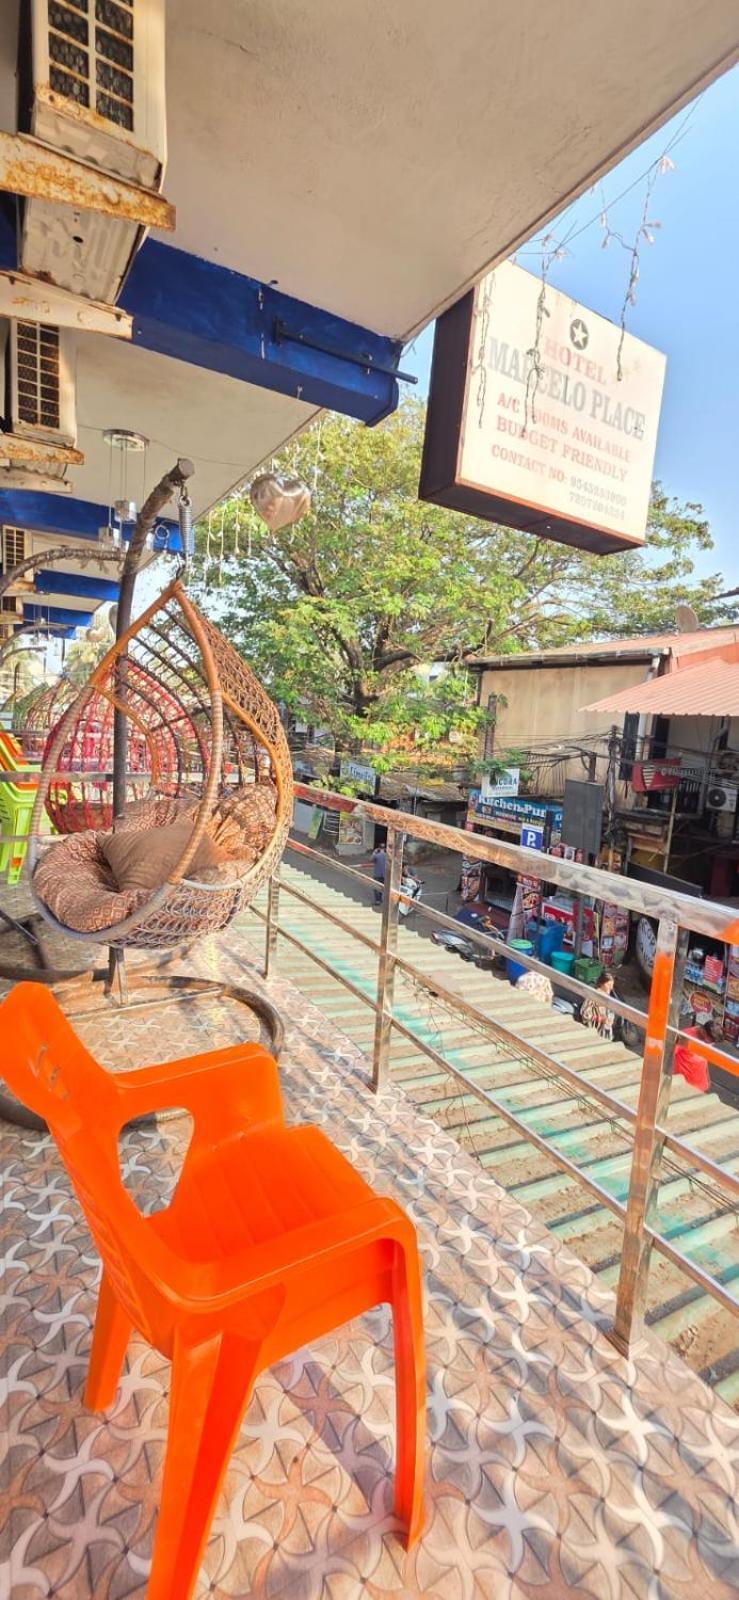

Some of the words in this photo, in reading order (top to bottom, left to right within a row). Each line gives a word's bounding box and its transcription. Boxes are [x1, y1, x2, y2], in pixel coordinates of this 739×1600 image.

[545, 336, 607, 385] HOTEL
[497, 393, 520, 413] A/C
[526, 403, 569, 435] OOMS
[572, 427, 631, 463] AVAILABLE
[590, 389, 646, 440] PLACE
[491, 444, 547, 476] CONTACT
[562, 444, 629, 482] FRIENDLY
[527, 831, 537, 846] P
